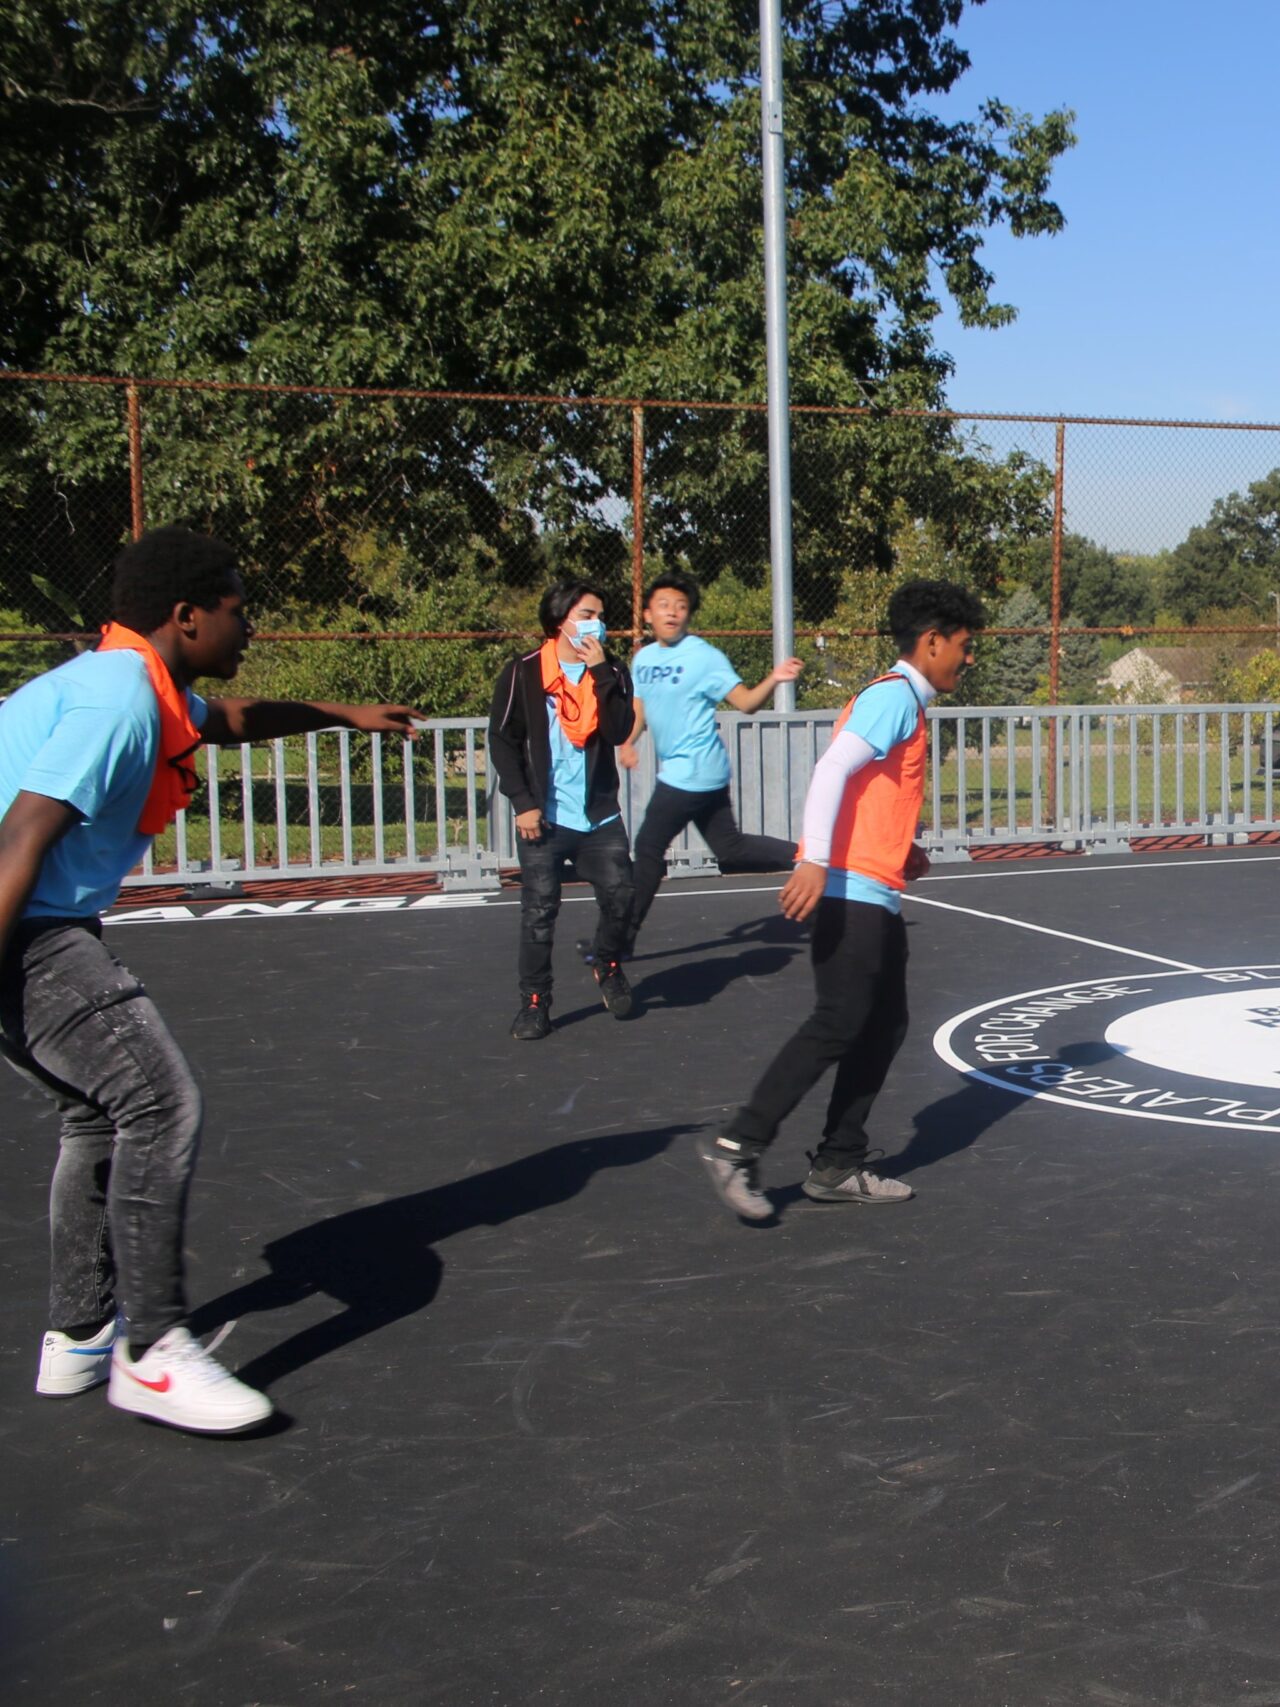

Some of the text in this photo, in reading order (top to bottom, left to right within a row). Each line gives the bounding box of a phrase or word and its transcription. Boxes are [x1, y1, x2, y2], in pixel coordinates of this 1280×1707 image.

[100, 892, 500, 922] ANGE
[980, 984, 1153, 1031] CHANGE
[974, 1033, 1051, 1063] FOR
